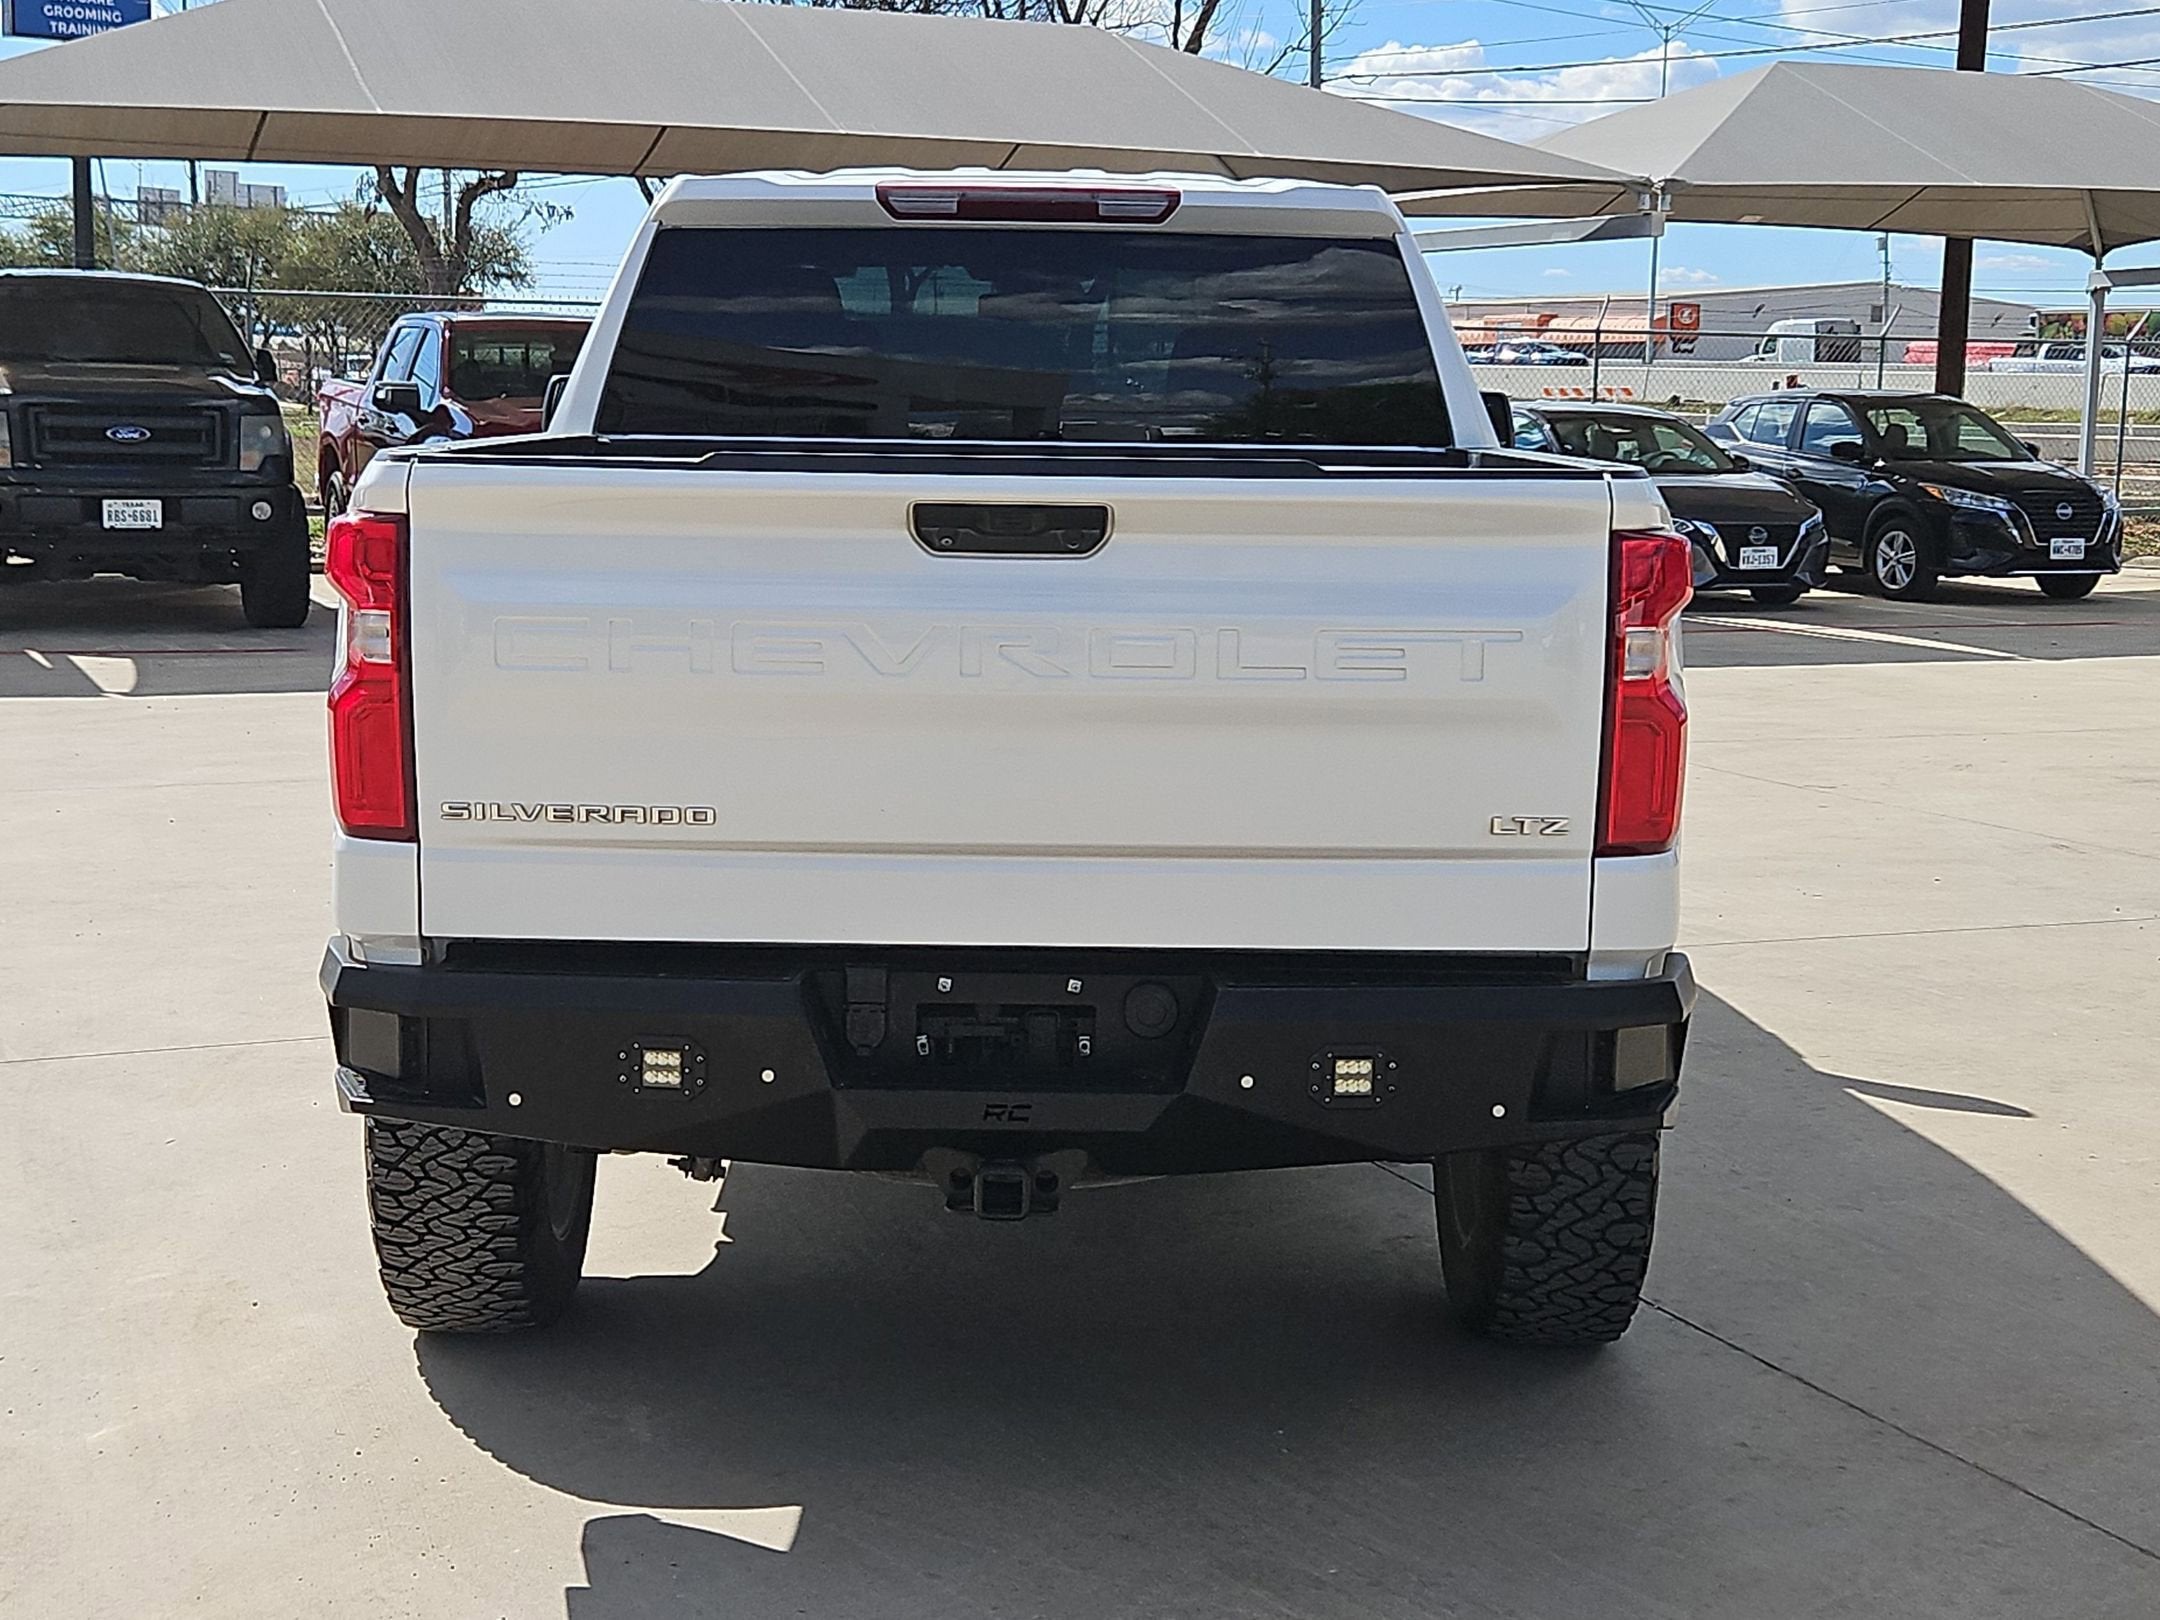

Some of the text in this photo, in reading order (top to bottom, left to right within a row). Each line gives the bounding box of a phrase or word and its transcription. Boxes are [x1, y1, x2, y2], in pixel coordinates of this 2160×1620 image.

[43, 4, 122, 23] GROOMING
[49, 21, 116, 36] TRAININ
[494, 616, 1523, 681] CHEVROLET
[440, 802, 717, 826] SILVERADO
[1490, 815, 1569, 836] LTZ
[983, 1103, 1032, 1122] RC
